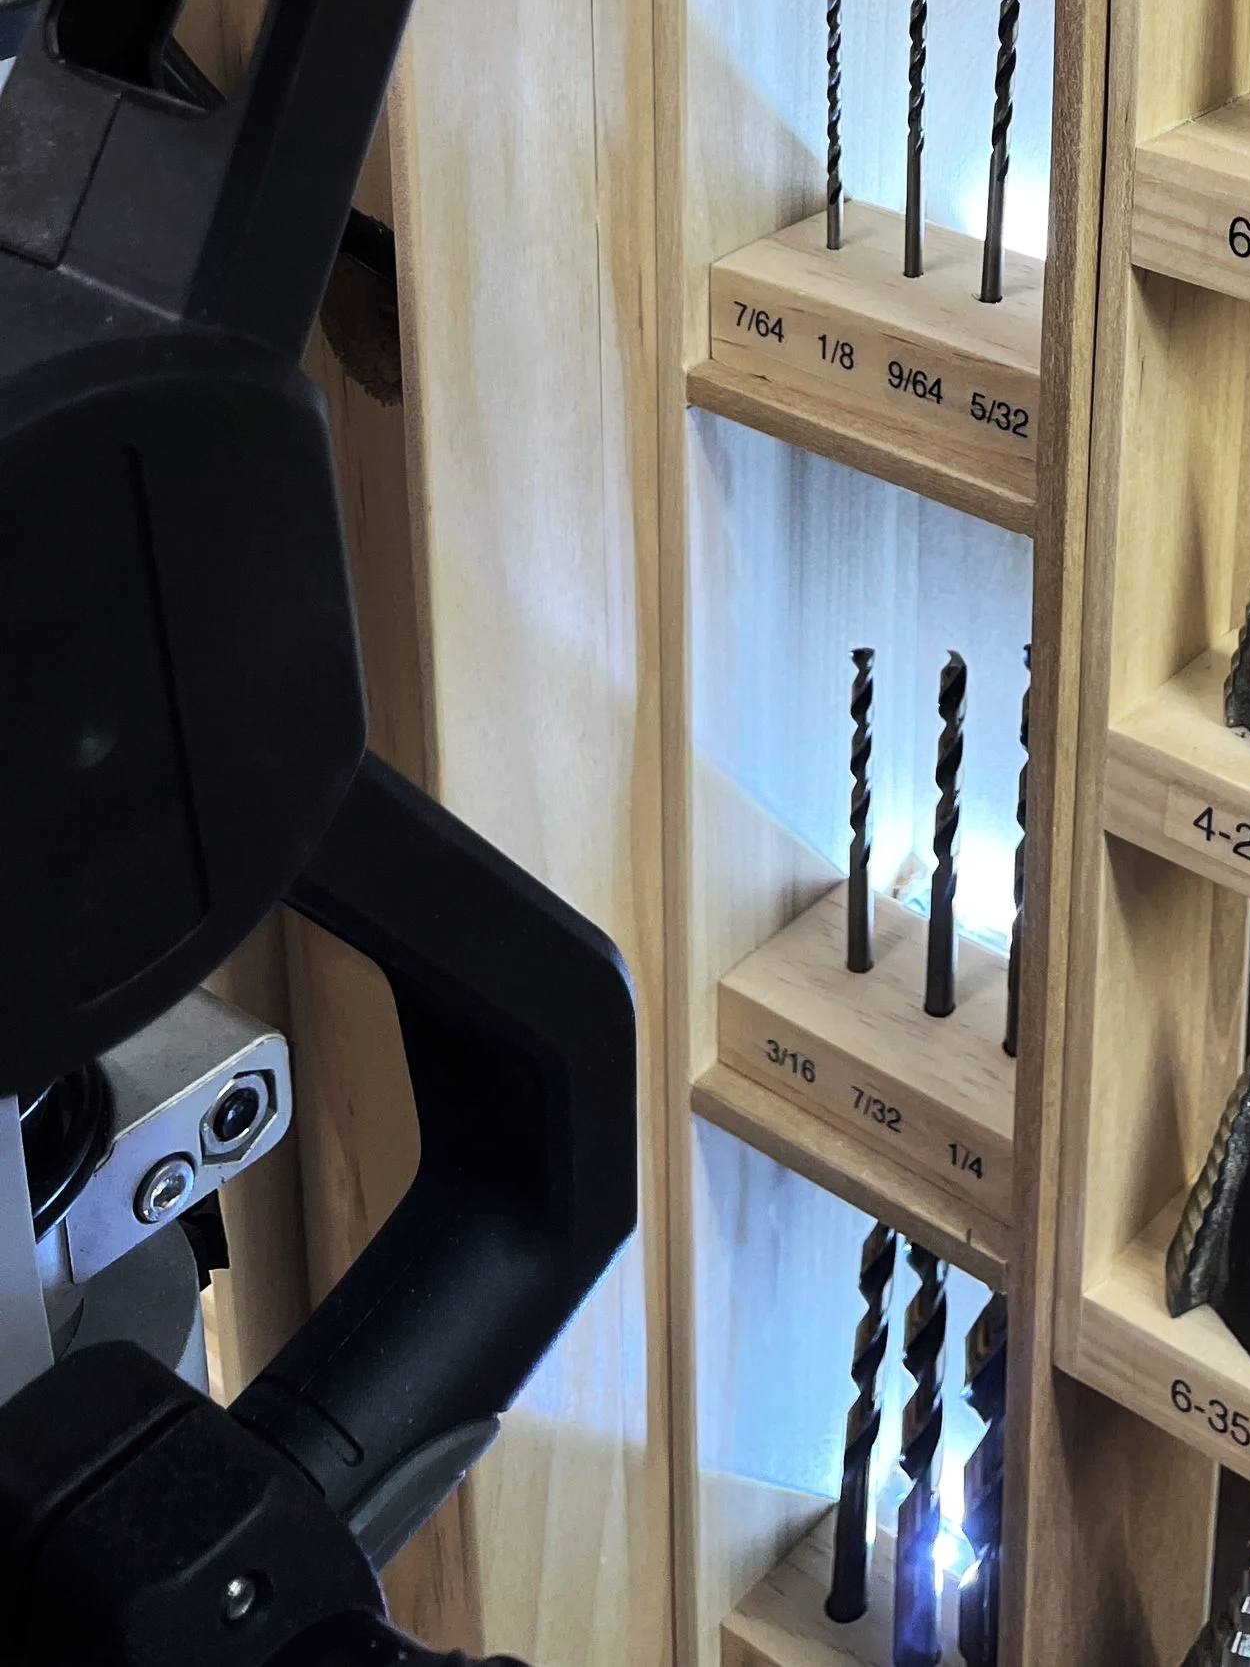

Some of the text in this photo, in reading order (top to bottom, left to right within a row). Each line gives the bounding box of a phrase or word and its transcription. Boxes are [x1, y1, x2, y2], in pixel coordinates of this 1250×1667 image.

[733, 301, 1029, 438] 7/64 1/8 9/64 5/32
[766, 1039, 985, 1179] 3/16 7/32 1/4
[1171, 1379, 1250, 1447] 6-35
